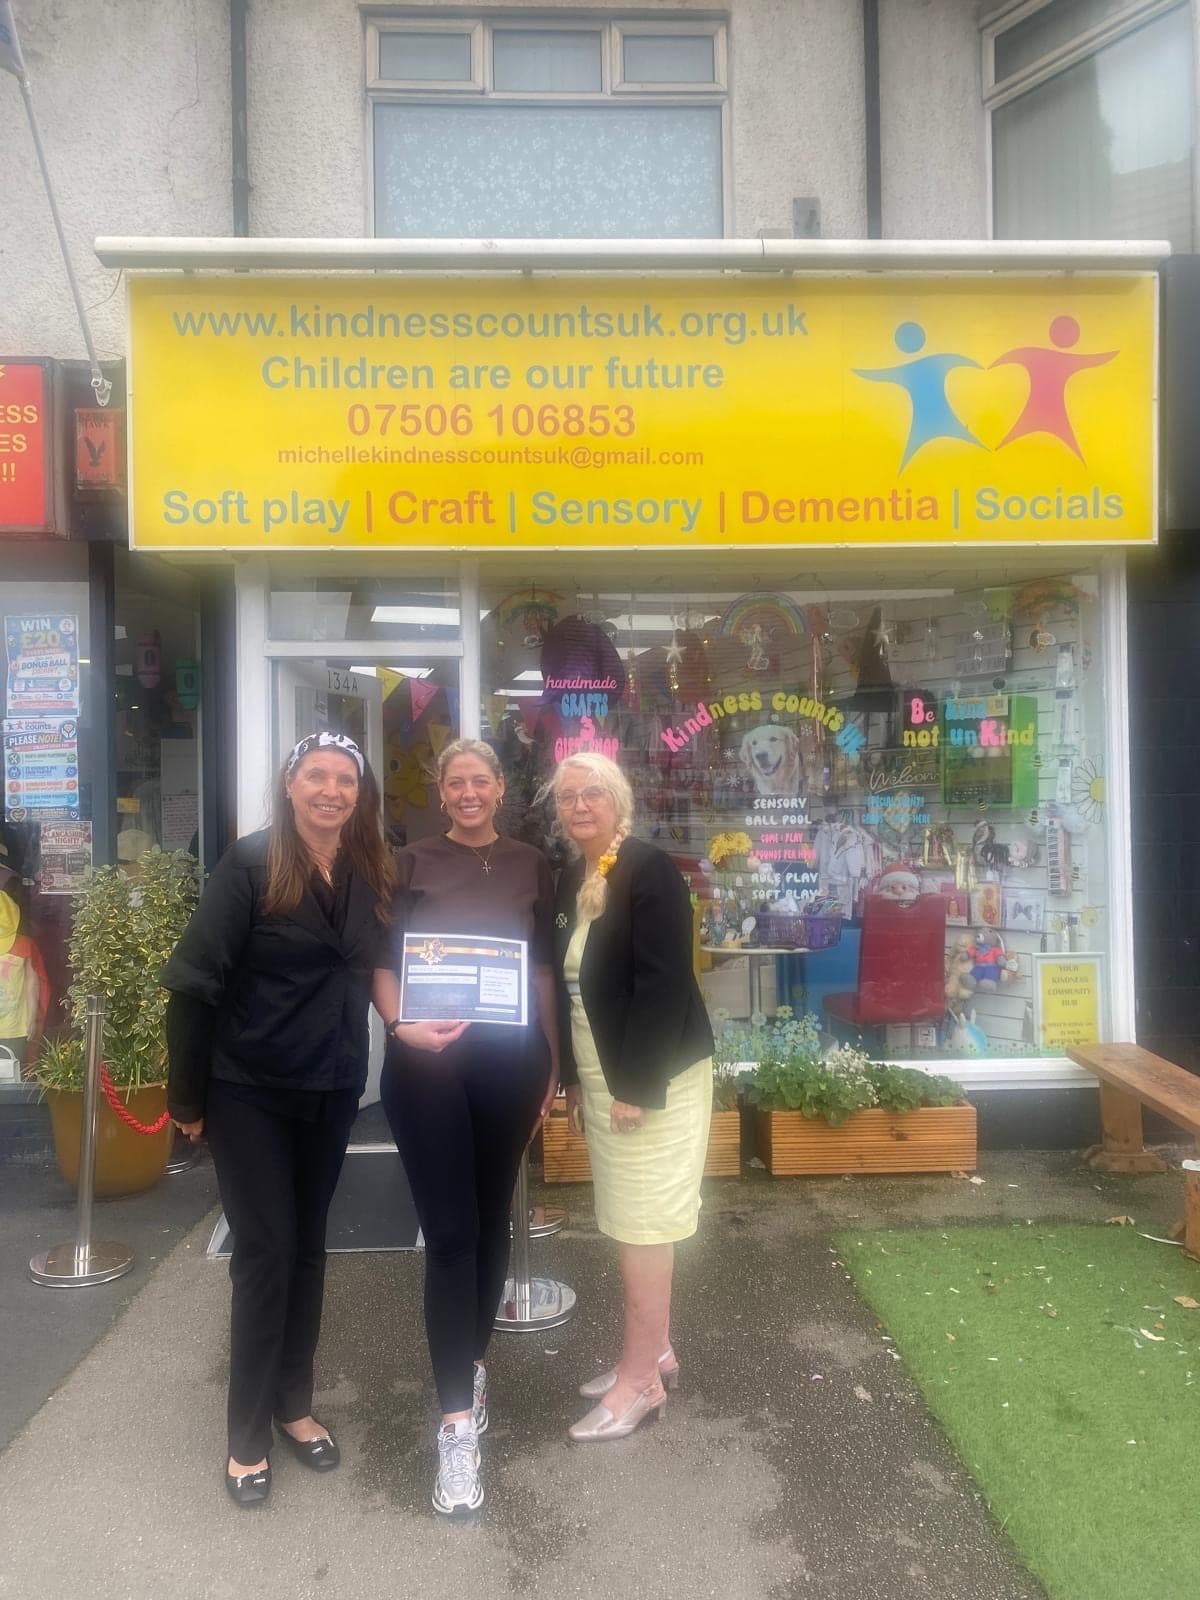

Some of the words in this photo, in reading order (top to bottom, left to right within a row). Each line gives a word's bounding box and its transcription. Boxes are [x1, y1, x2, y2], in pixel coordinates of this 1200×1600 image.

[172, 304, 808, 345] www.kindnesscountsuk.org.uk
[261, 355, 436, 390] Children
[448, 363, 511, 390] are
[524, 363, 594, 390] our
[605, 355, 725, 390] future
[347, 403, 473, 437] 07506
[487, 403, 636, 437] 106853
[277, 445, 704, 469] michellekindnesscountsuk@gmail.com
[162, 490, 250, 526] Soft
[263, 490, 350, 533] play
[388, 490, 495, 526] Craft
[531, 489, 702, 532] Sensory
[741, 488, 939, 525] Dementia
[975, 486, 1124, 521] Socials
[20, 618, 51, 632] WIN
[327, 670, 359, 692] 134A
[546, 674, 618, 690] handmade
[561, 692, 609, 718] CRAFTS
[910, 697, 936, 724] Be
[660, 692, 763, 752] Kindness
[9, 735, 38, 747] PLEASE
[903, 725, 941, 747] not
[753, 798, 808, 810] SENSORY
[745, 815, 779, 826] BALL
[782, 814, 813, 825] POOL
[785, 872, 819, 884] PLAY
[751, 889, 781, 901] SOFT
